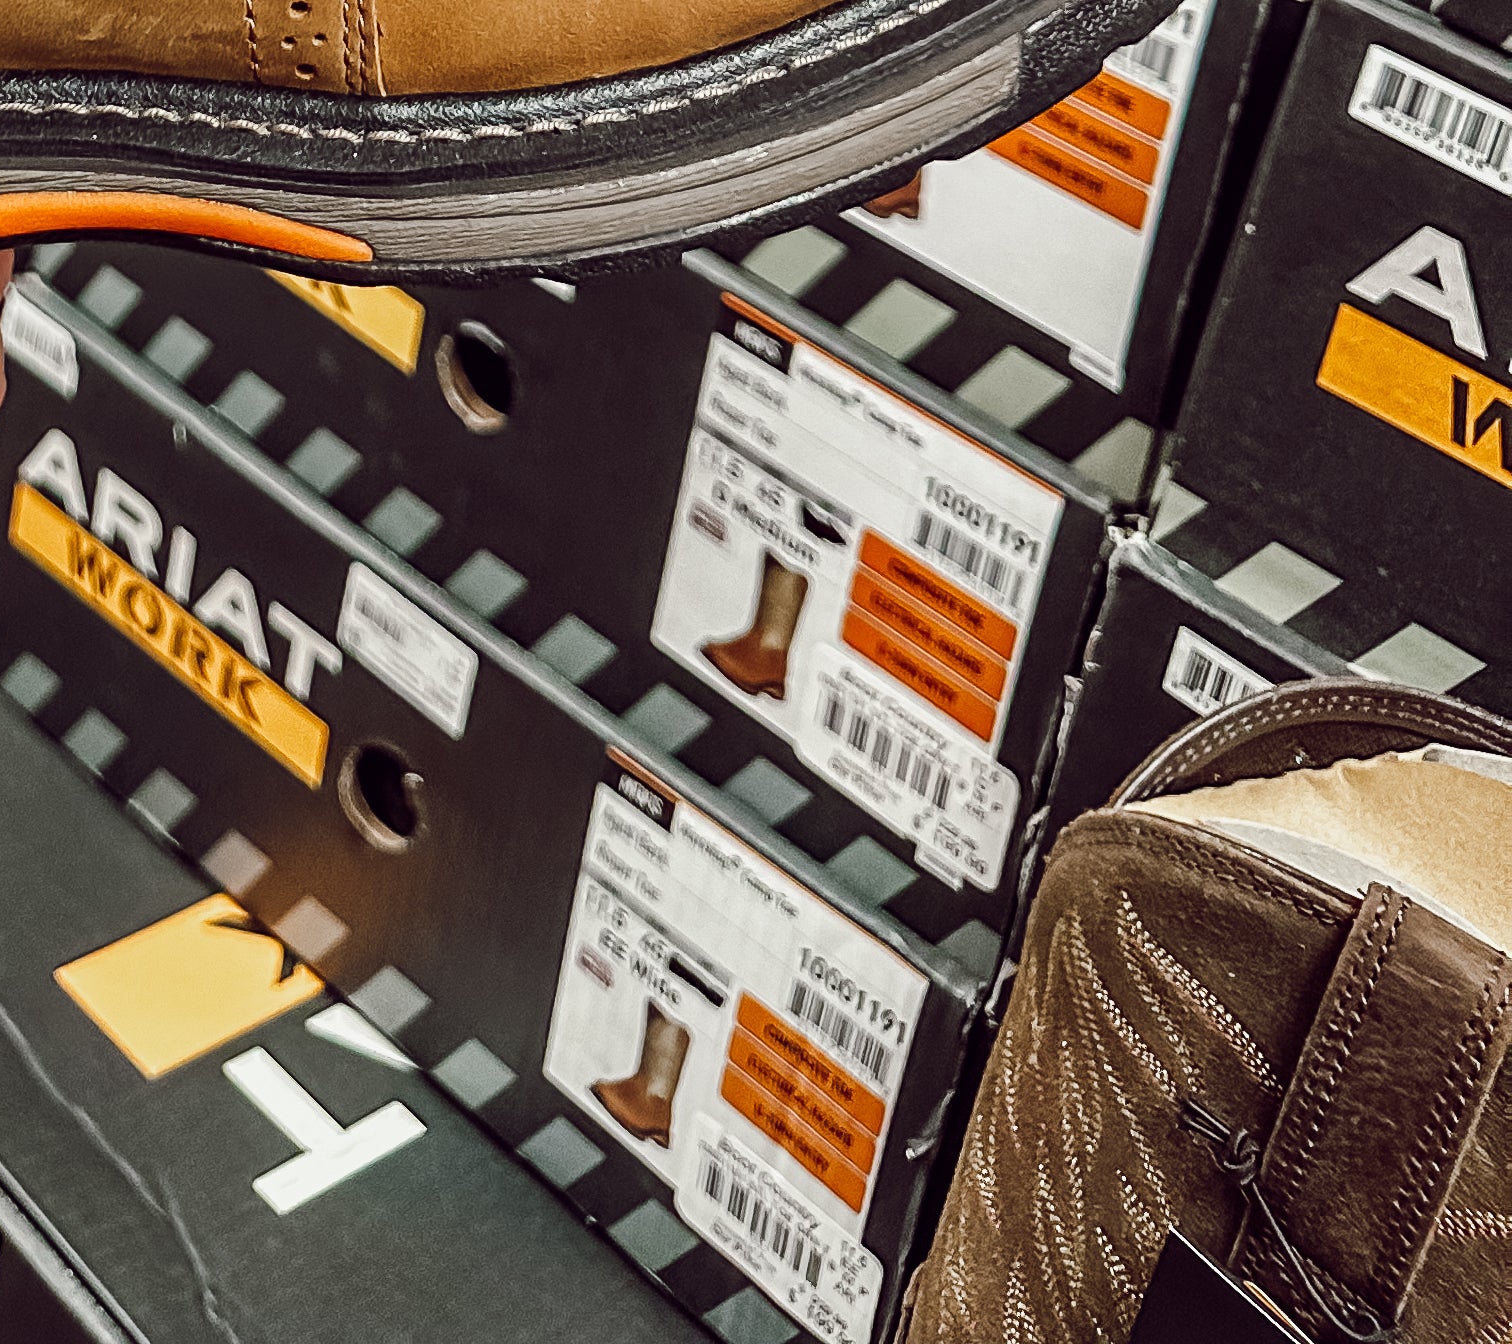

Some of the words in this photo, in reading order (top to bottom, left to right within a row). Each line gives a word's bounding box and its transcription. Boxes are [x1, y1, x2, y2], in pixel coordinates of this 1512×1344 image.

[17, 427, 343, 701] ARIAT
[924, 475, 1042, 565] 10001191
[65, 528, 263, 725] WORK
[798, 946, 908, 1045] 10001191
